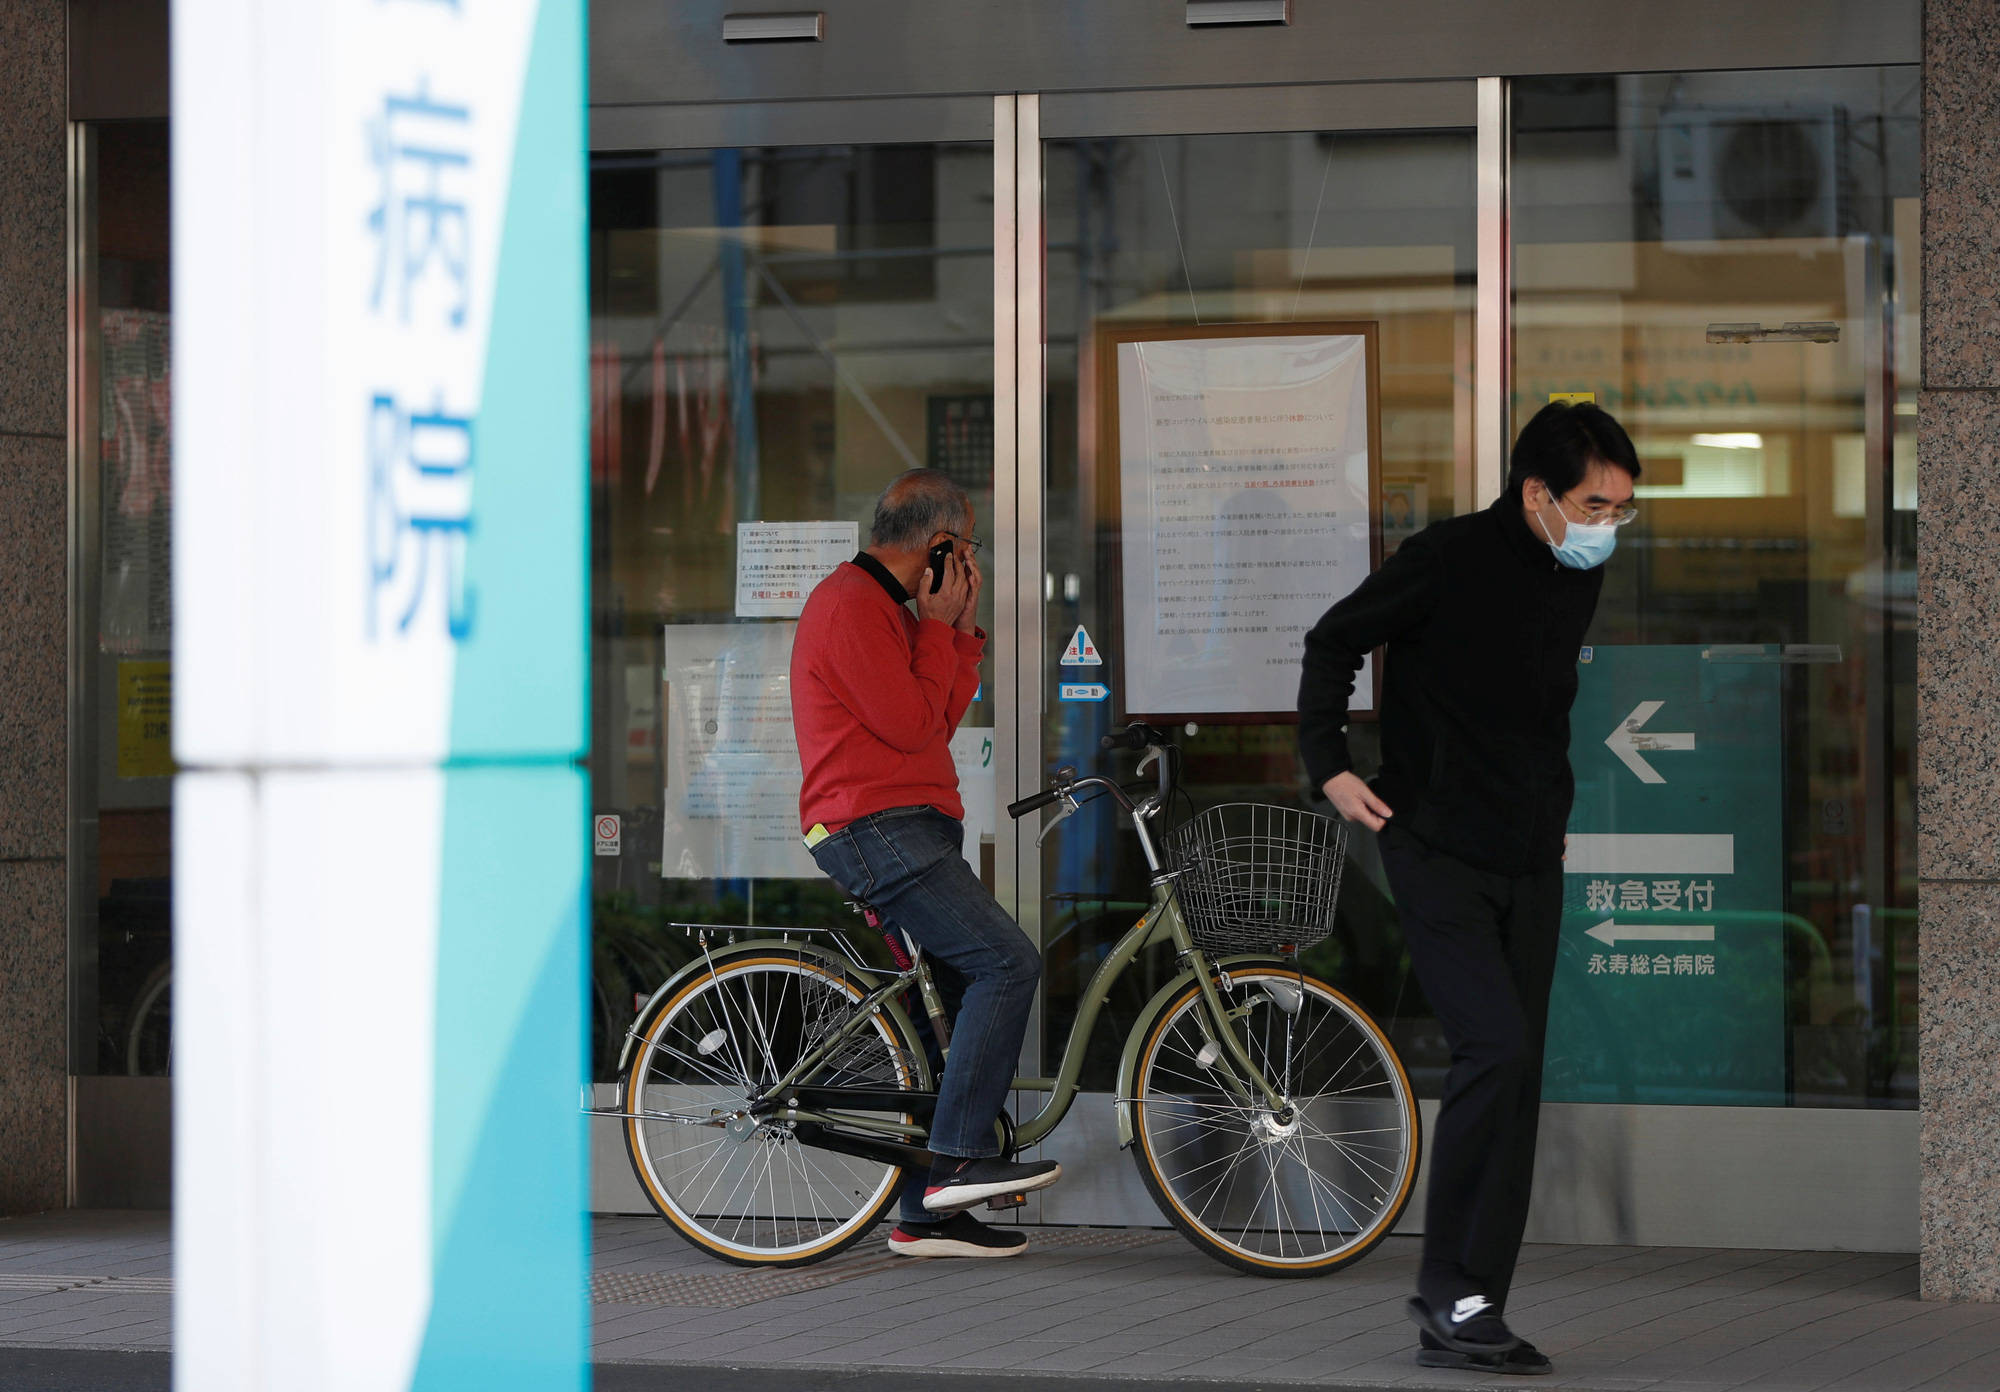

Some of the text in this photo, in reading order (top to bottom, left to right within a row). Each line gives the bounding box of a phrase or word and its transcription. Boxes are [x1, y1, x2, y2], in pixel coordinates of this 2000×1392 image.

[362, 0, 478, 642] 病院
[1586, 880, 1715, 912] 救急受付
[1587, 954, 1715, 975] 永寿総合病院
